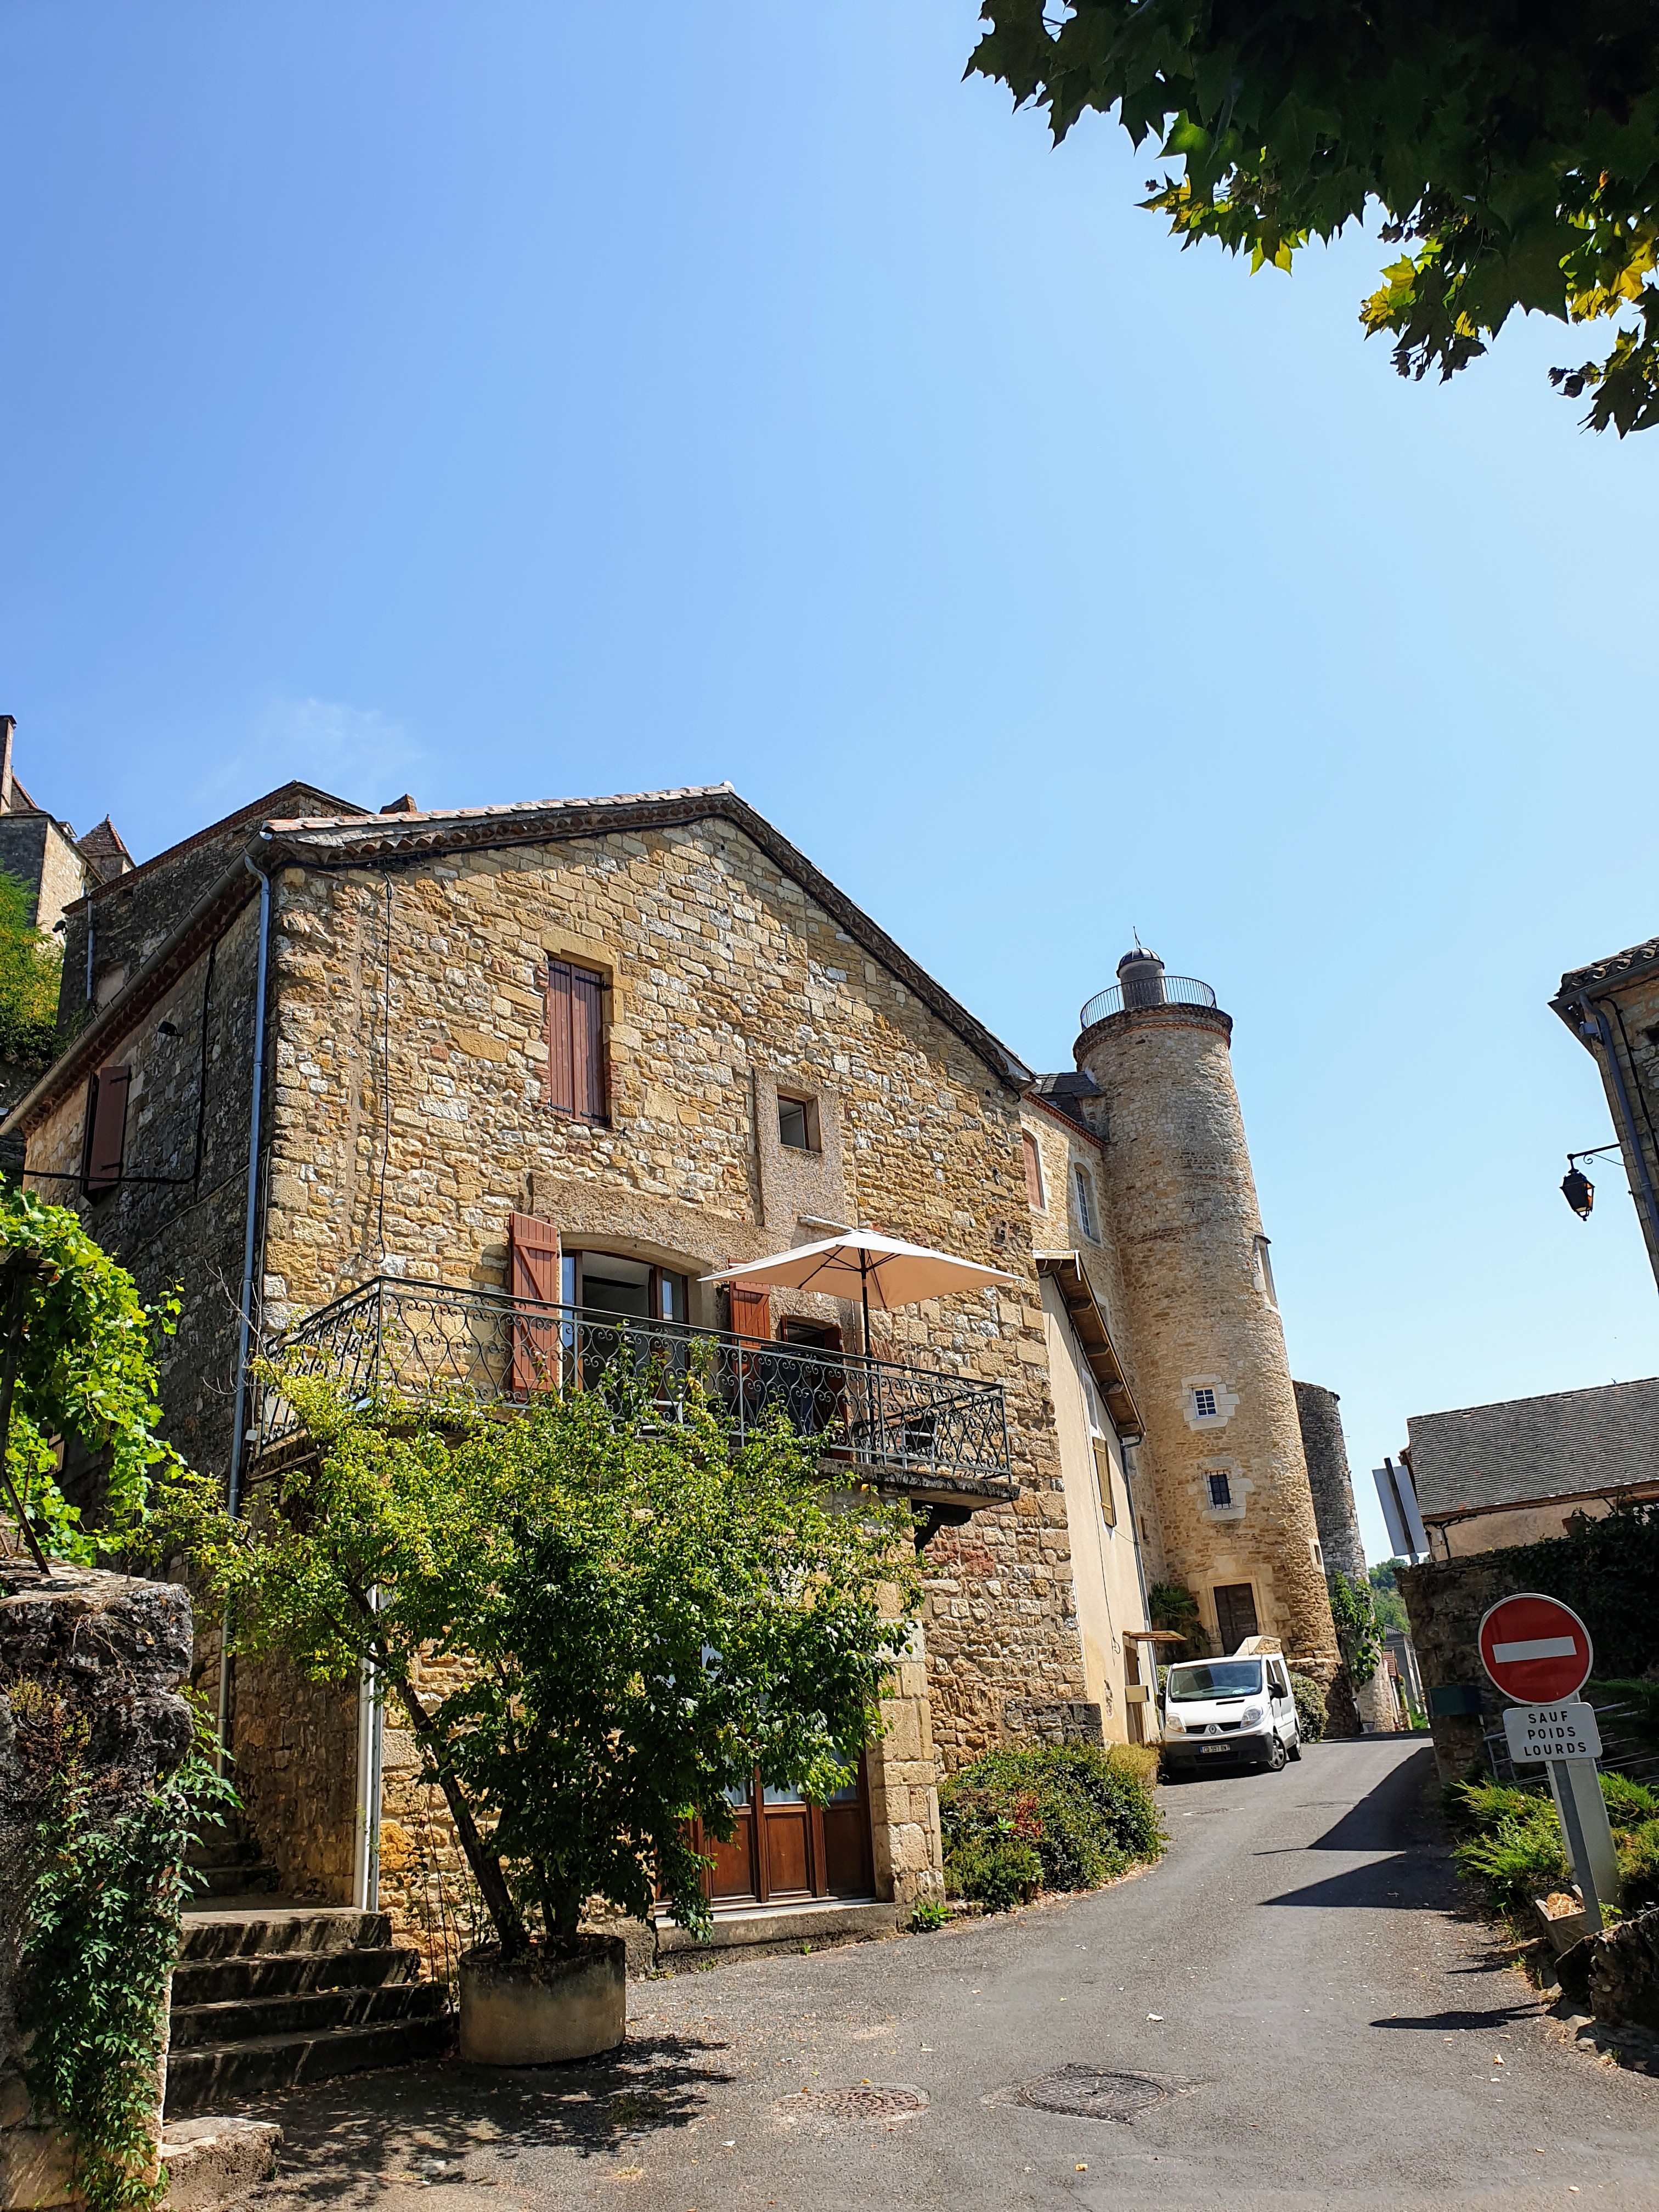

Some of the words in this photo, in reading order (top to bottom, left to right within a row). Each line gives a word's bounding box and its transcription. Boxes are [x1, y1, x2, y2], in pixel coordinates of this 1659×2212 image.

[1528, 1711, 1568, 1724] SAUF
[1527, 1726, 1576, 1740] POIDS
[1523, 1742, 1587, 1757] LOURDS
